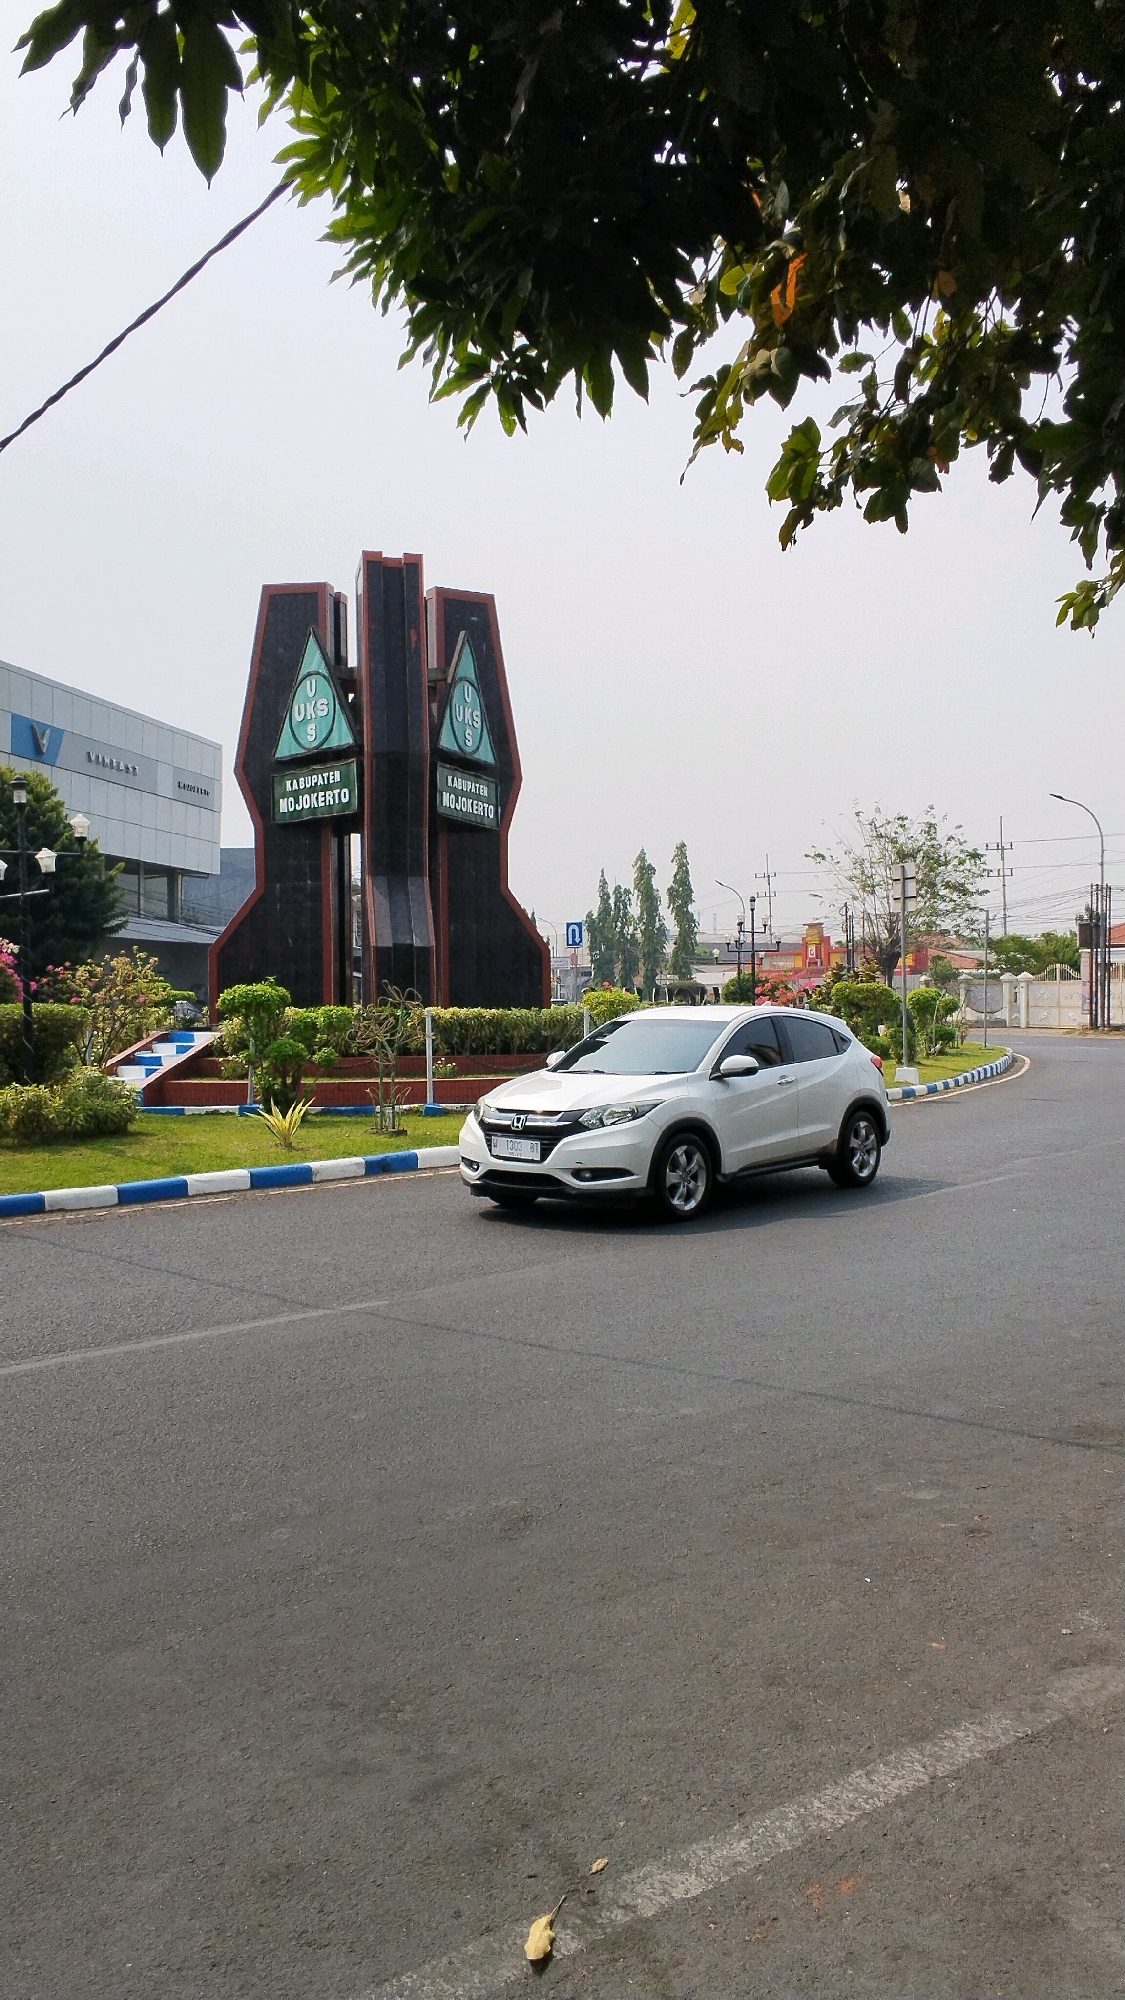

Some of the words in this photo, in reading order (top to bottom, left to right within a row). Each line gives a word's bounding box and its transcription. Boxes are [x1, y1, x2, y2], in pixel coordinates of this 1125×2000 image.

[306, 678, 316, 697] U
[463, 686, 472, 703] U
[294, 698, 328, 722] UKS
[455, 706, 481, 729] UKS
[306, 723, 316, 742] S
[464, 729, 473, 747] S
[285, 770, 341, 792] KABUPATEN
[447, 775, 488, 797] KABUPATEN
[279, 788, 350, 813] MOJOKERTO
[442, 791, 494, 819] MOJOKERTO
